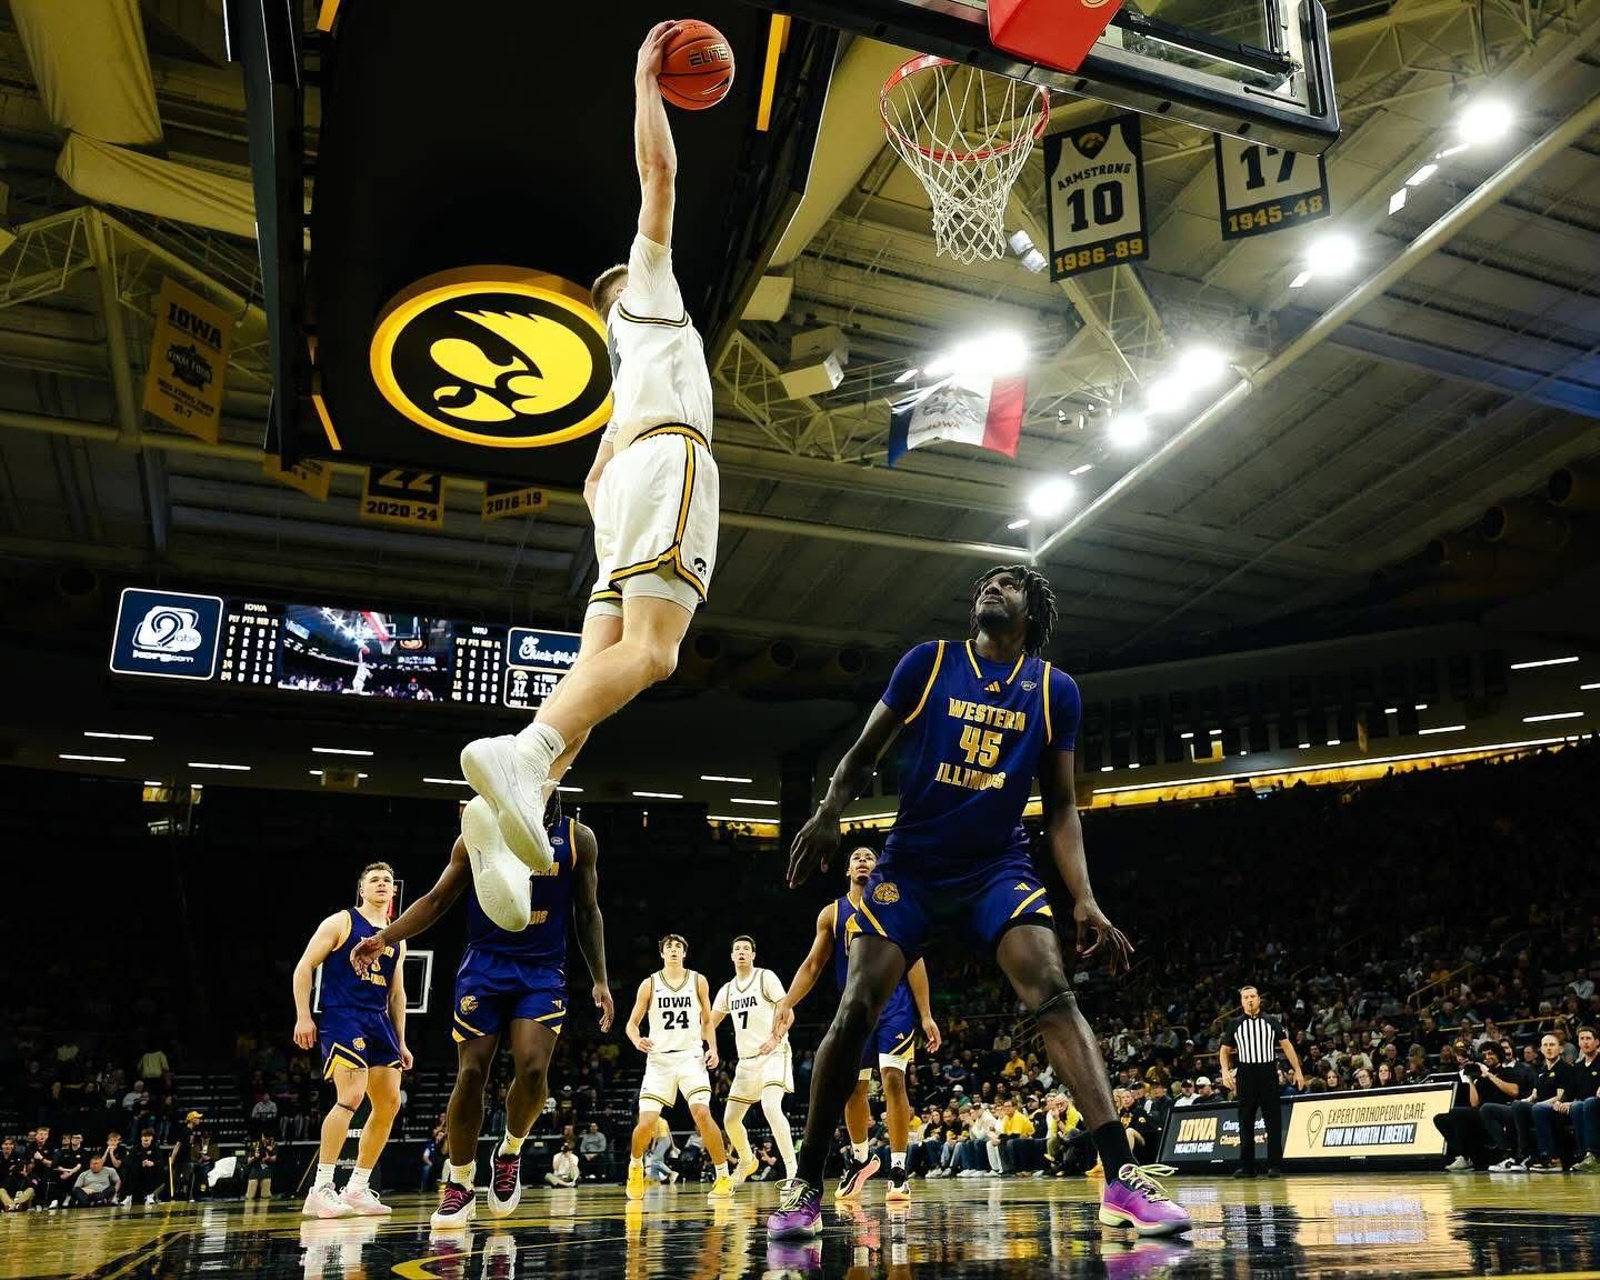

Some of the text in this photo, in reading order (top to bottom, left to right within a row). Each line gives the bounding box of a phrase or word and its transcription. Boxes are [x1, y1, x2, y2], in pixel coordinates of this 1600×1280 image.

[689, 49, 729, 66] ELITE
[1057, 162, 1131, 191] ARMSTRONG
[1066, 180, 1124, 232] 10
[1228, 195, 1324, 232] 1945-48
[1055, 237, 1144, 274] 1986-89
[168, 301, 222, 349] IOWA
[366, 501, 437, 521] 2020-24
[244, 603, 268, 612] IOWA
[947, 697, 1026, 731] WESTERN
[960, 725, 1003, 768] 45
[658, 996, 692, 1008] IOWA
[731, 996, 758, 1010] IOWA
[662, 1010, 690, 1030] 24
[738, 1011, 748, 1029] 7
[1327, 1108, 1355, 1125] EXPERT
[1355, 1104, 1403, 1123] ORTHOPEDIC
[1176, 1117, 1217, 1142] IOWA
[1324, 1124, 1414, 1146] NOW IN NORTH LIBERTY.
[1174, 1141, 1214, 1154] HEALTH CARE
